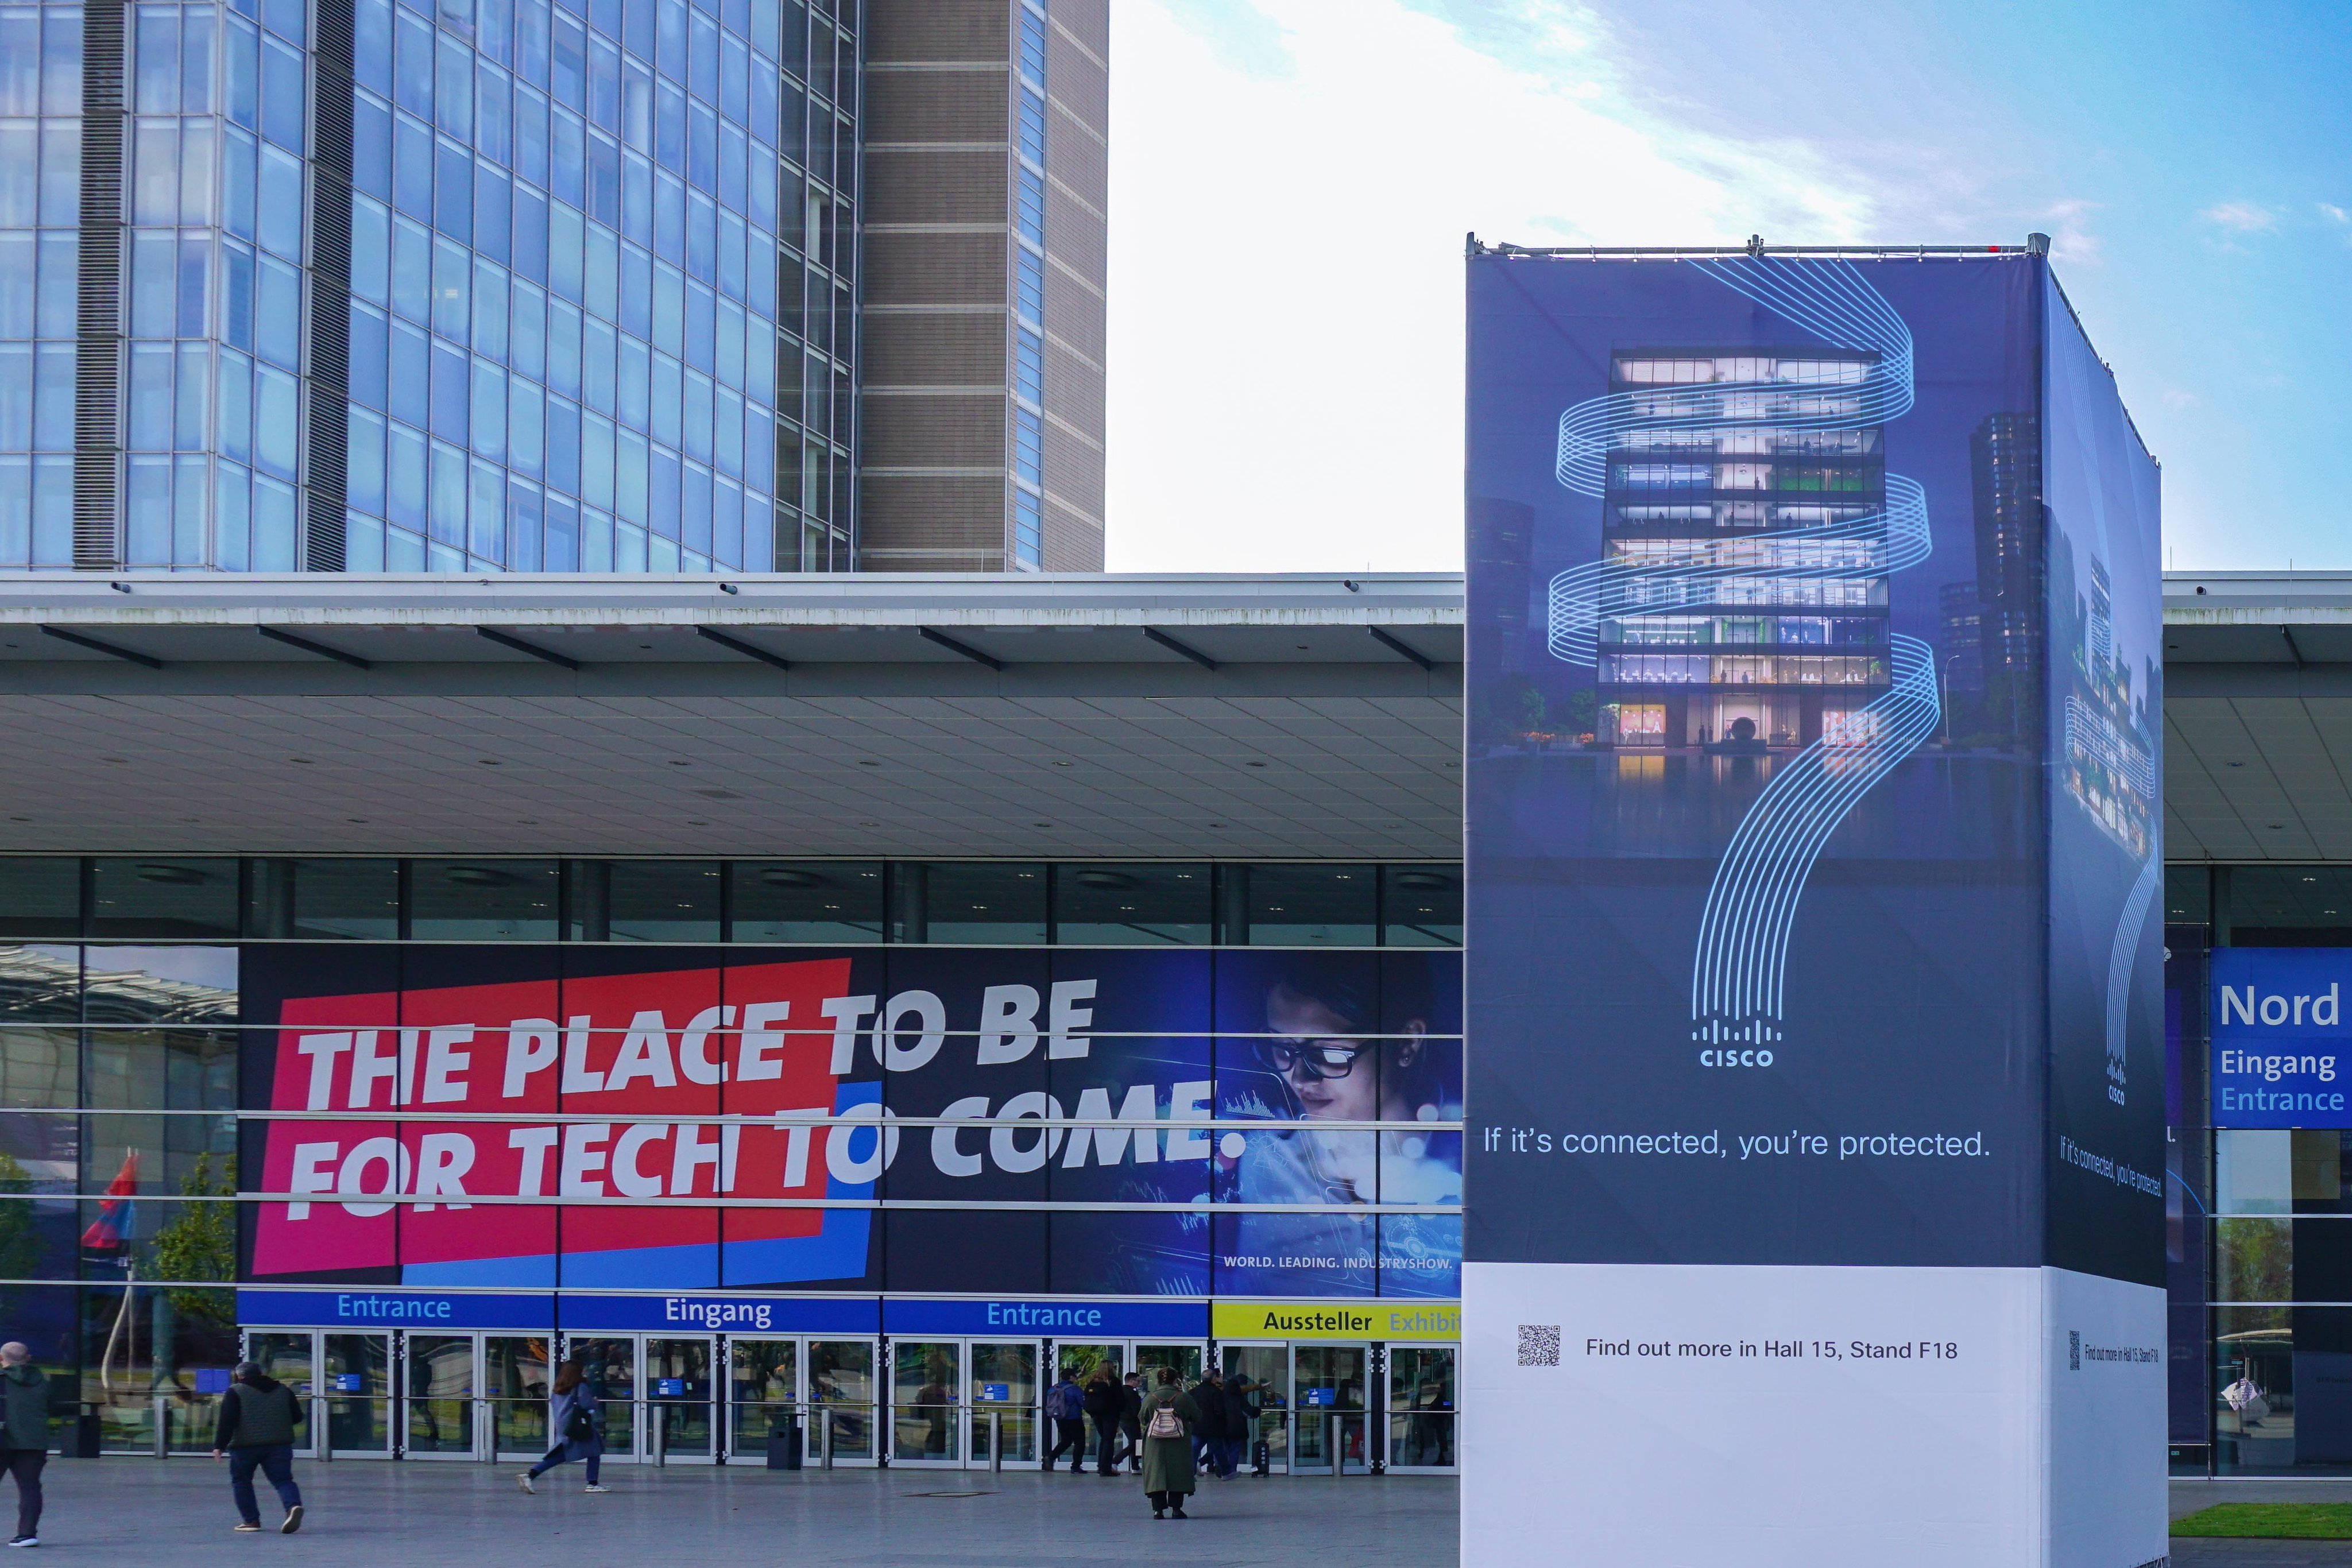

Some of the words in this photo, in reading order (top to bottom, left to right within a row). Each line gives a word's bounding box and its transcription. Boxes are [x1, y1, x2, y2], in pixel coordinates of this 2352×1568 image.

[2222, 983, 2338, 1025] Nord
[298, 1023, 475, 1111] THE
[502, 1001, 790, 1098] PLACE
[821, 990, 946, 1075] TO
[977, 979, 1098, 1065] BE
[2222, 1050, 2336, 1082] Eingang
[2222, 1087, 2345, 1111] Entrance
[287, 1133, 475, 1221] FOR
[508, 1113, 741, 1200] TECH
[774, 1103, 900, 1188] TO
[931, 1079, 1246, 1177] COME.
[1485, 1128, 1502, 1152] If
[1512, 1128, 1552, 1153] it's
[1562, 1130, 1726, 1159] connected,
[1738, 1130, 1828, 1160] you're
[1840, 1131, 1990, 1160] protected.
[2060, 1135, 2065, 1160] If
[2067, 1138, 2079, 1165] it's
[2080, 1149, 2115, 1183] connected,
[2117, 1163, 2136, 1187] you're
[2137, 1172, 2163, 1198] protected.
[1224, 1256, 1275, 1268] WORLD.
[1279, 1256, 1340, 1268] LEADING.
[1344, 1257, 1453, 1269] INDUSTRYSHOW.
[338, 1295, 451, 1318] Entrance
[666, 1298, 772, 1329] Eingang
[988, 1302, 1101, 1327] Entrance
[1263, 1312, 1372, 1331] Aussteller
[1587, 1339, 1630, 1356] Find
[1638, 1341, 1671, 1357] out
[1678, 1344, 1732, 1357] more
[1740, 1341, 1757, 1357] in
[1765, 1341, 1802, 1357] Hall
[1812, 1341, 1843, 1361] 15,
[1850, 1341, 1911, 1358] Stand
[1920, 1342, 1958, 1359] F18
[2085, 1344, 2095, 1360] Find
[2106, 1349, 2117, 1362] more
[2118, 1347, 2123, 1362] in
[2124, 1347, 2132, 1362] Hall
[2140, 1348, 2150, 1363] Stand
